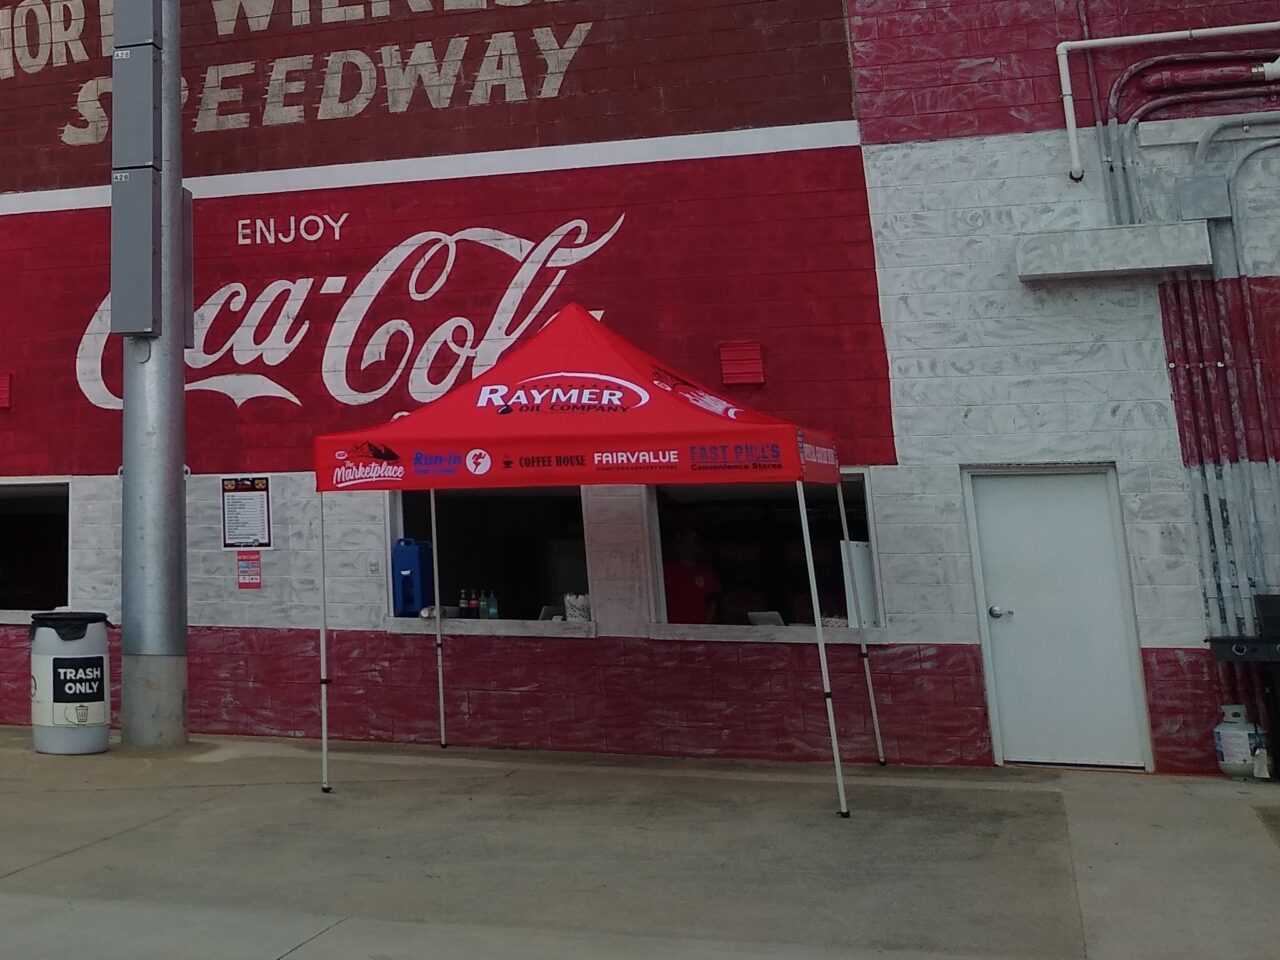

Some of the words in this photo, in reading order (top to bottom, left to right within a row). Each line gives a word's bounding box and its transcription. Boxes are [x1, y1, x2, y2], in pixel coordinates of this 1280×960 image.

[57, 22, 593, 146] SEEDWAY
[236, 213, 350, 246] ENJOY
[477, 384, 624, 407] RAYMER
[518, 405, 540, 413] OIL
[550, 404, 630, 413] COMPANY
[519, 456, 552, 468] COFFEE
[555, 455, 586, 467] HOUSE
[593, 450, 679, 465] FAIRVALUE
[689, 445, 729, 463] FAST
[333, 461, 405, 485] Marketplace
[690, 463, 749, 471] Convenience
[752, 462, 783, 470] Stores
[57, 667, 101, 680] TRASH
[64, 681, 99, 694] ONLY
